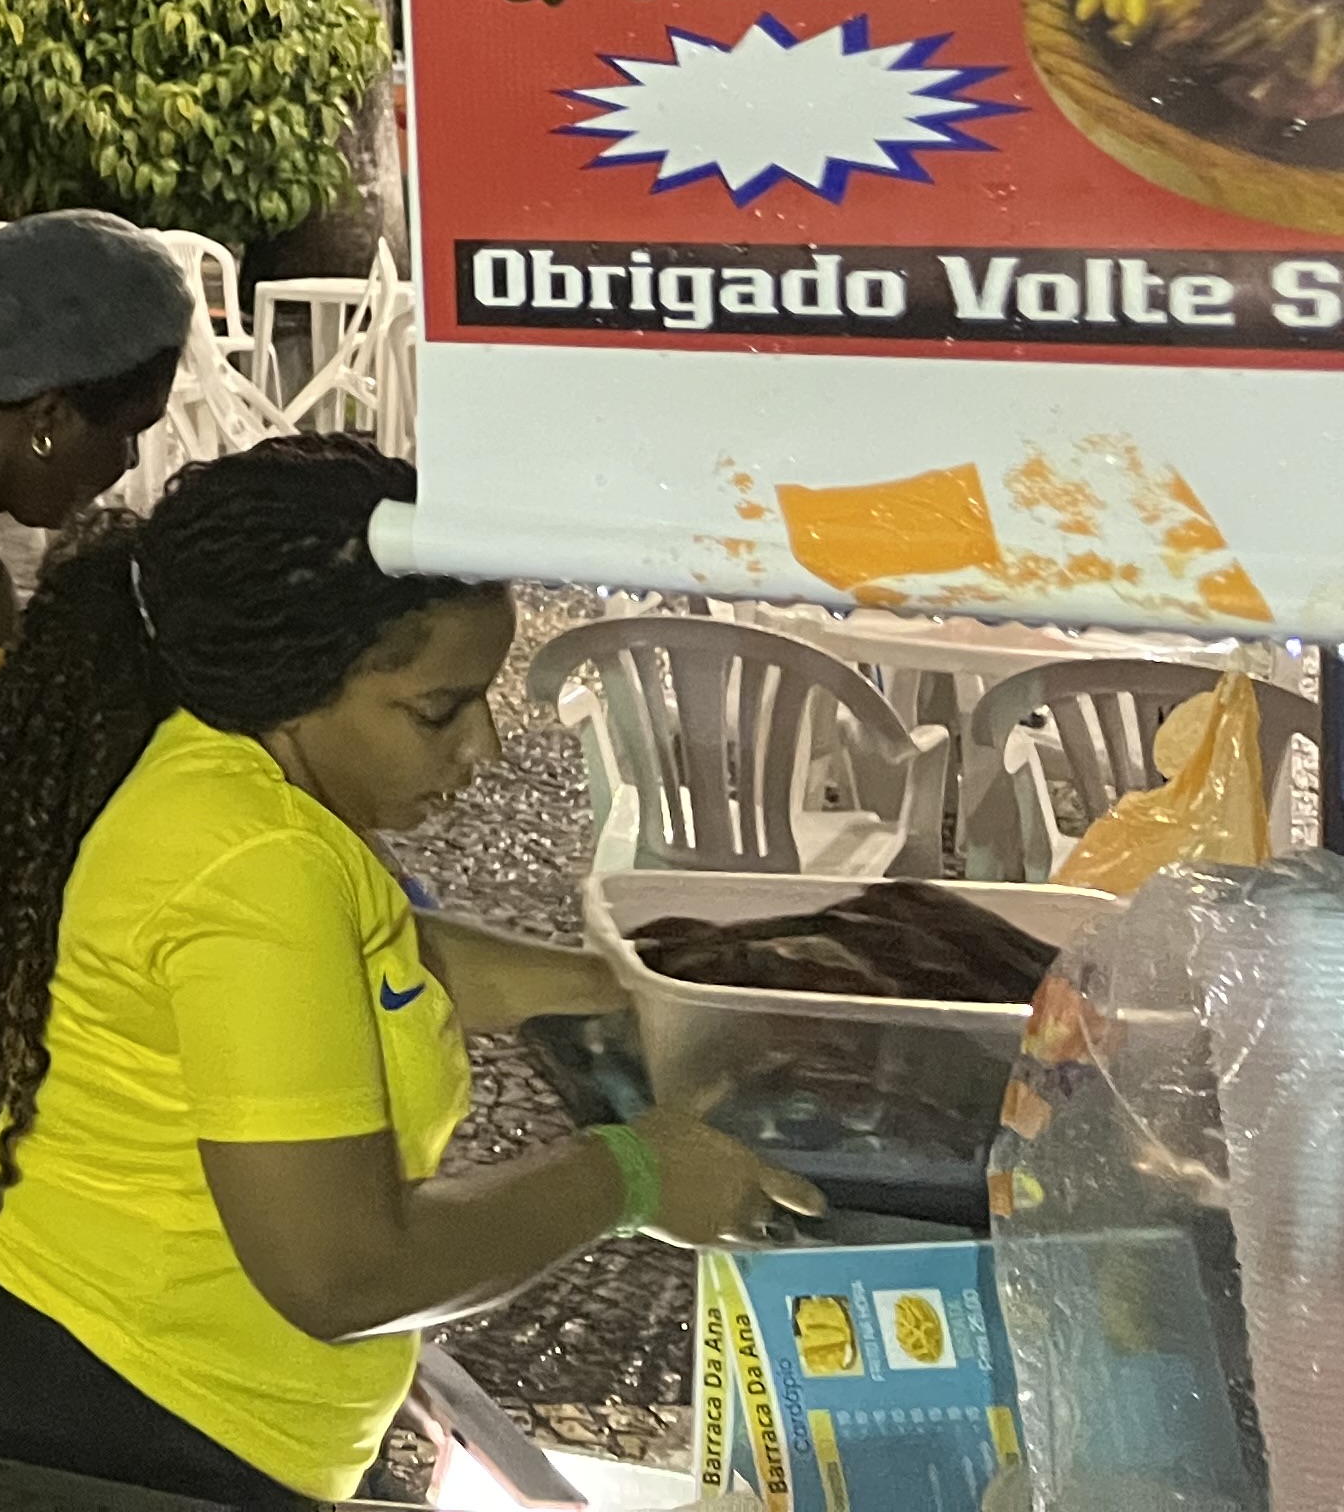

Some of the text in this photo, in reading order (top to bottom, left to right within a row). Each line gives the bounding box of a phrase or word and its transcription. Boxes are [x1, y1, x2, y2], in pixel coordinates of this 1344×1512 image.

[470, 247, 910, 330] Obrigado
[936, 255, 1237, 327] Volte
[702, 1306, 723, 1487] Barraca Da Ana
[735, 1313, 788, 1494] Barraca Da Ana
